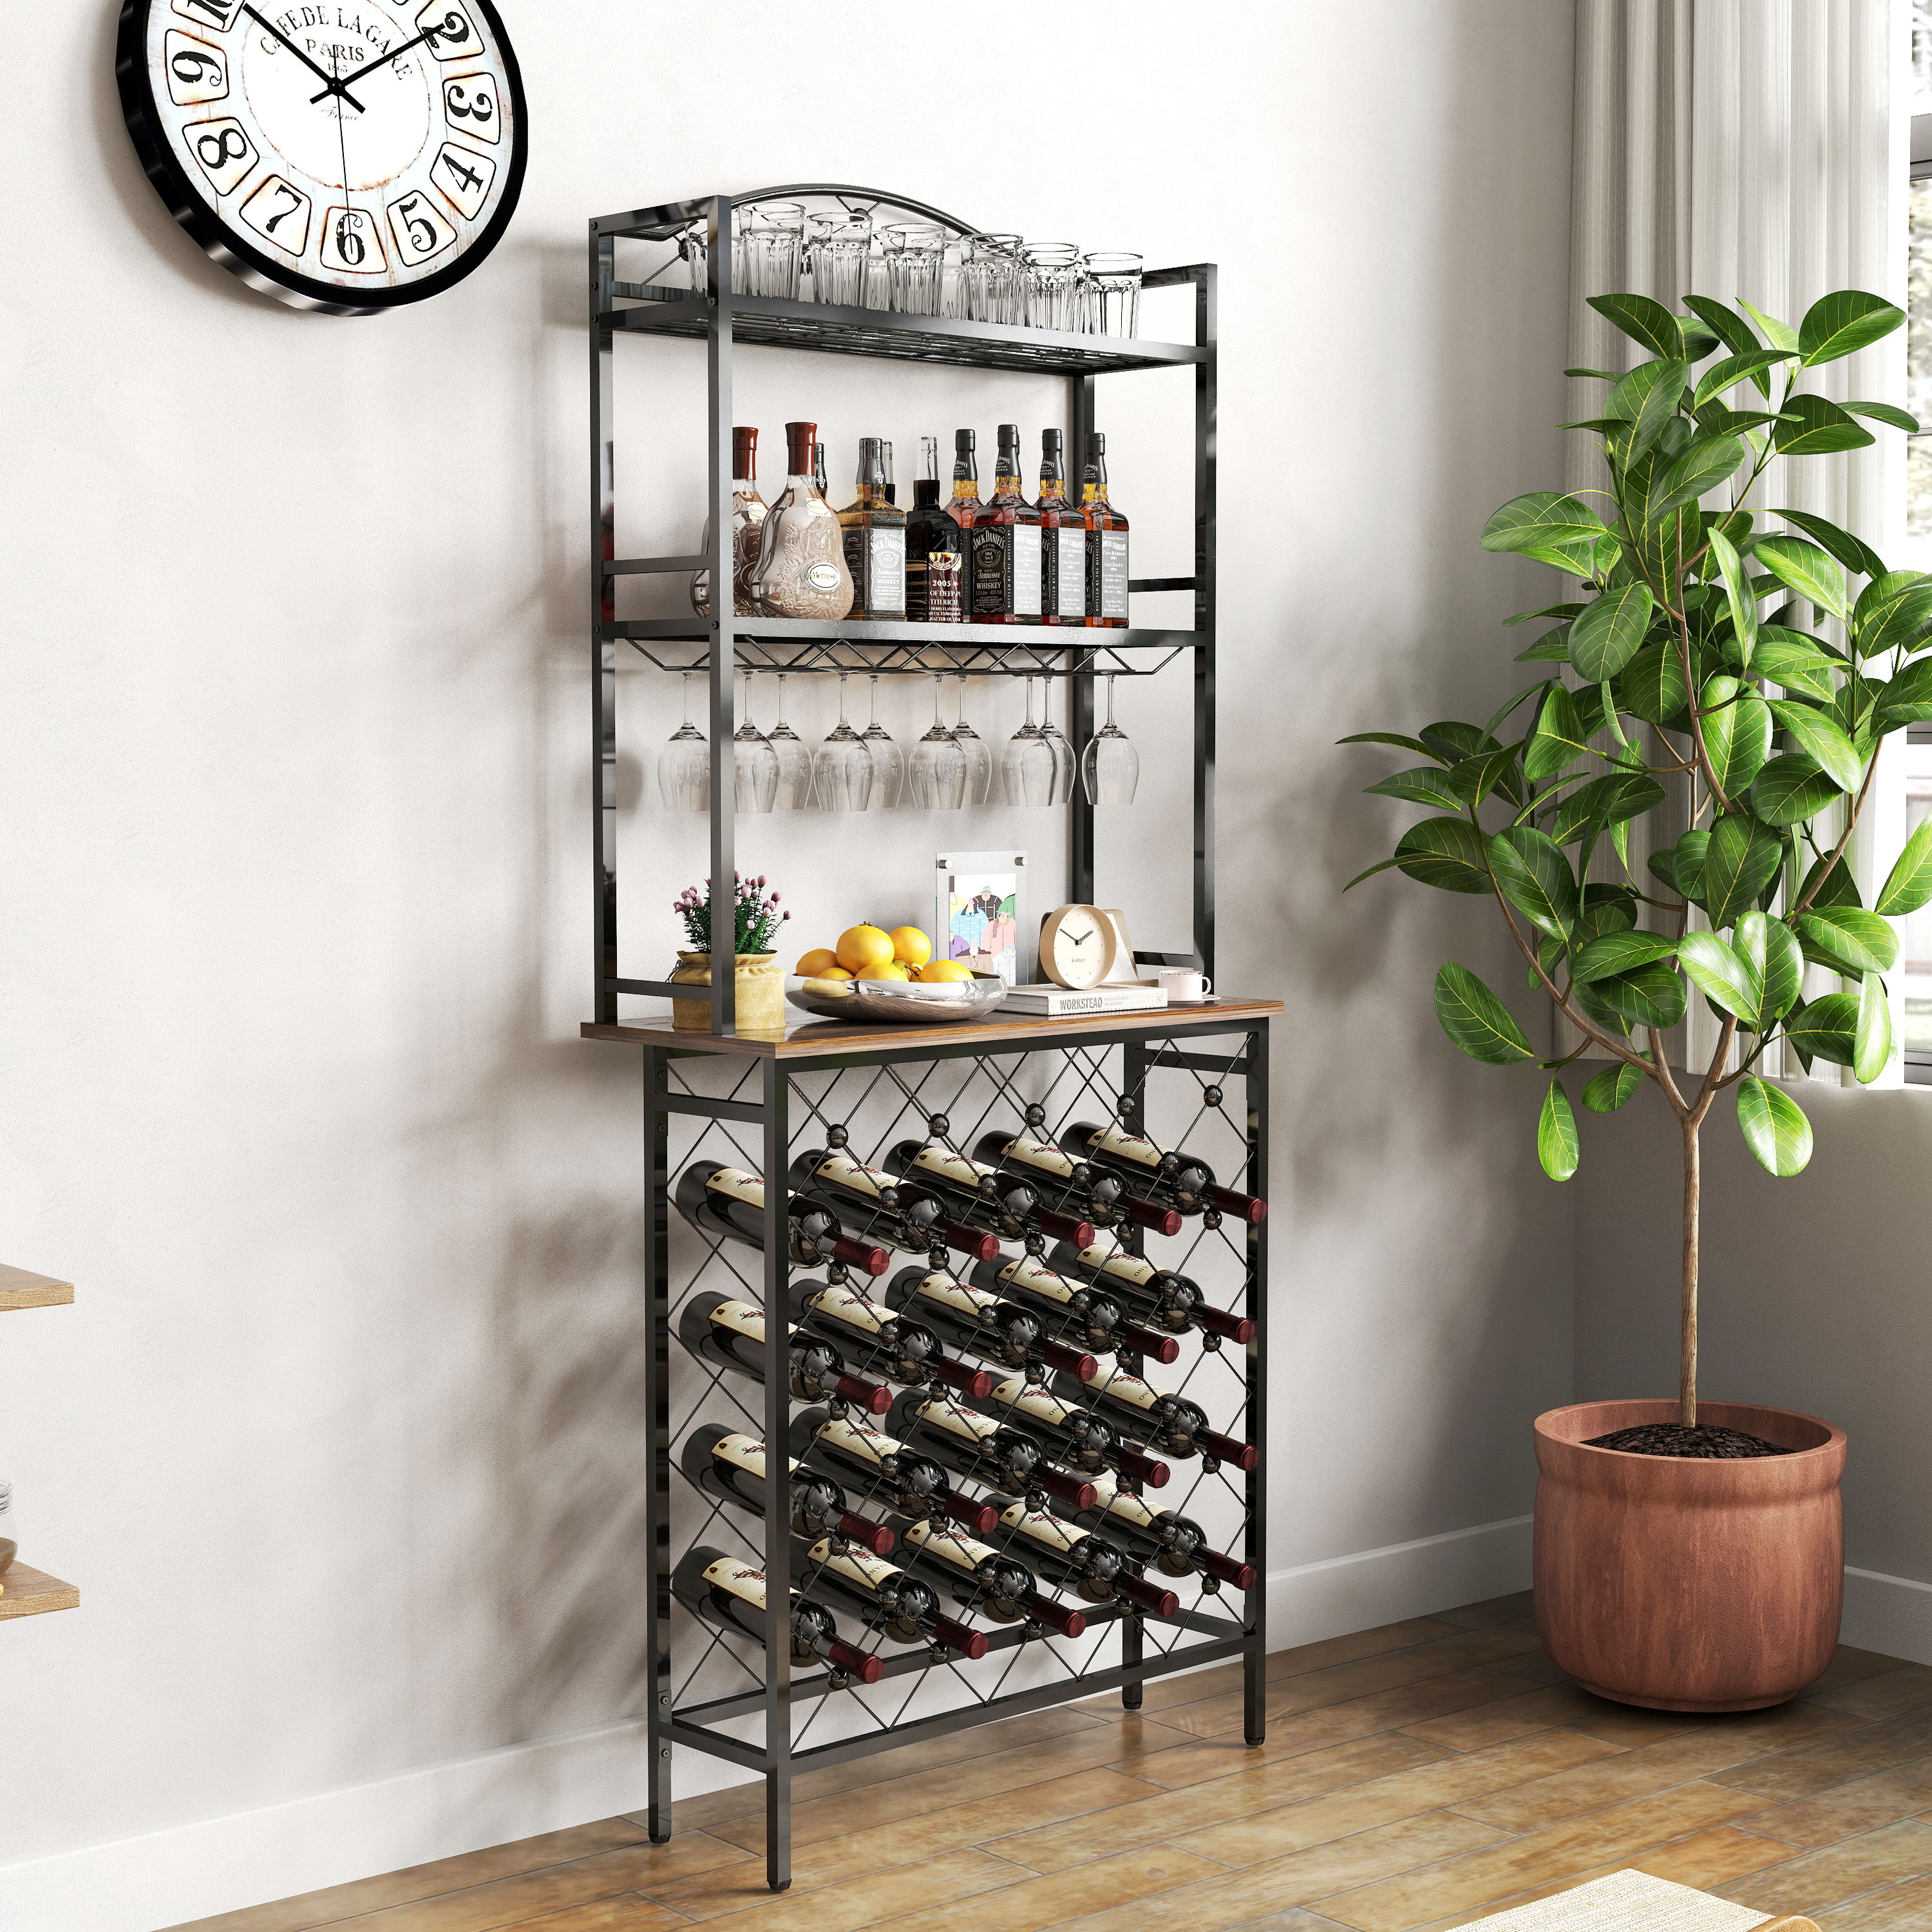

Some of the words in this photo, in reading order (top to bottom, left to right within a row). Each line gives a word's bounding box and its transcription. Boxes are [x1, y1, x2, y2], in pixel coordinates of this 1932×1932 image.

[301, 6, 329, 27] DE
[337, 8, 362, 34] LA
[422, 12, 469, 49] 2
[172, 51, 222, 86] 9
[305, 39, 365, 62] PARIS
[448, 85, 493, 122] 3
[198, 128, 247, 169] 8
[442, 153, 484, 194] 4
[266, 184, 303, 233] 7
[399, 198, 438, 253] 5
[336, 213, 365, 265] 6
[973, 534, 985, 550] JACK
[985, 529, 1005, 549] DANIEL'S
[978, 569, 1001, 579] Tennessee
[1060, 997, 1103, 1010] WORKSTEAD
